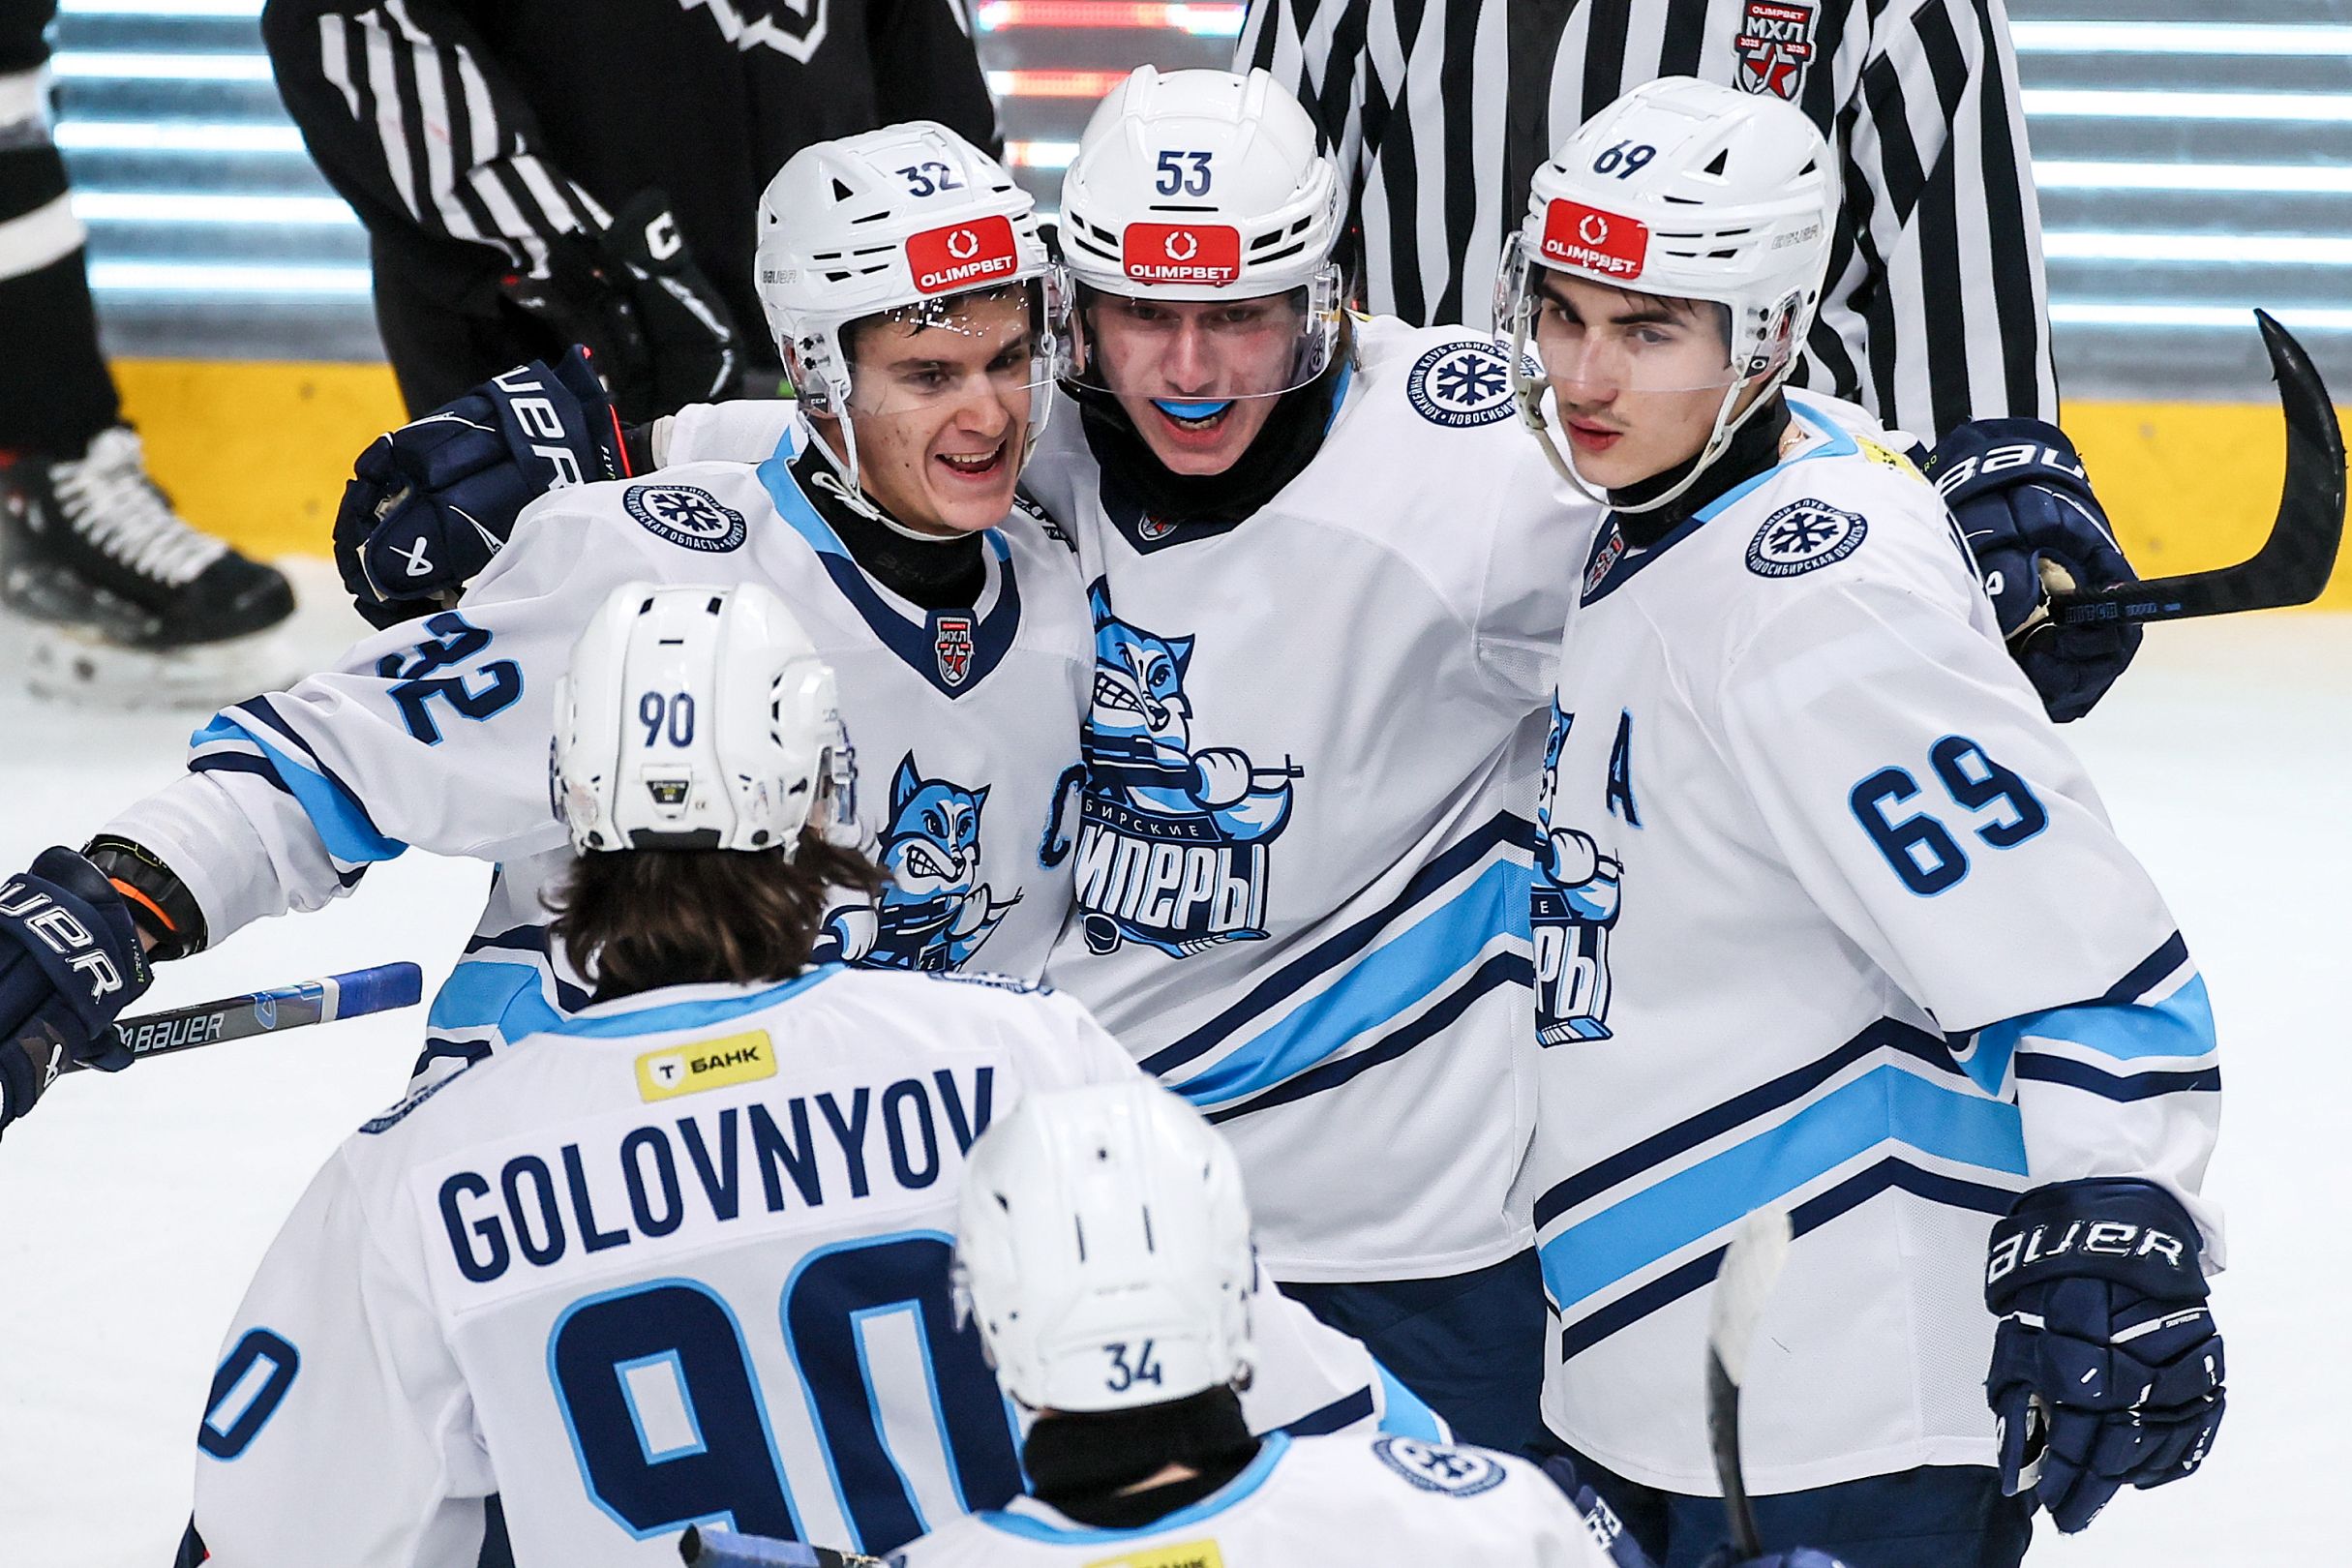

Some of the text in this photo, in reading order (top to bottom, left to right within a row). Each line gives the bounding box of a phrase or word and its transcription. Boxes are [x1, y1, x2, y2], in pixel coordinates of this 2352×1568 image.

[1746, 15, 1804, 43] МХЛ
[1752, 6, 1804, 19] OLIMPBET
[895, 162, 965, 197] 32
[1156, 150, 1213, 196] 53
[1593, 139, 1656, 180] 69
[920, 256, 1013, 287] OLIMPBET
[1130, 264, 1233, 280] OLIMPBET
[1546, 239, 1637, 274] OLIMPBET
[1419, 345, 1447, 371] КЛУБ
[669, 529, 721, 551] ОБЛАСТЬ
[376, 610, 525, 747] 32
[640, 691, 695, 748] 90
[1606, 706, 1643, 829] A
[1038, 760, 1094, 870] C
[1848, 734, 2049, 898] 69
[690, 1045, 761, 1074] БАНК
[437, 1067, 995, 1283] GOLOVNYOV
[1103, 1339, 1161, 1392] 34
[546, 1229, 1034, 1560] 90
